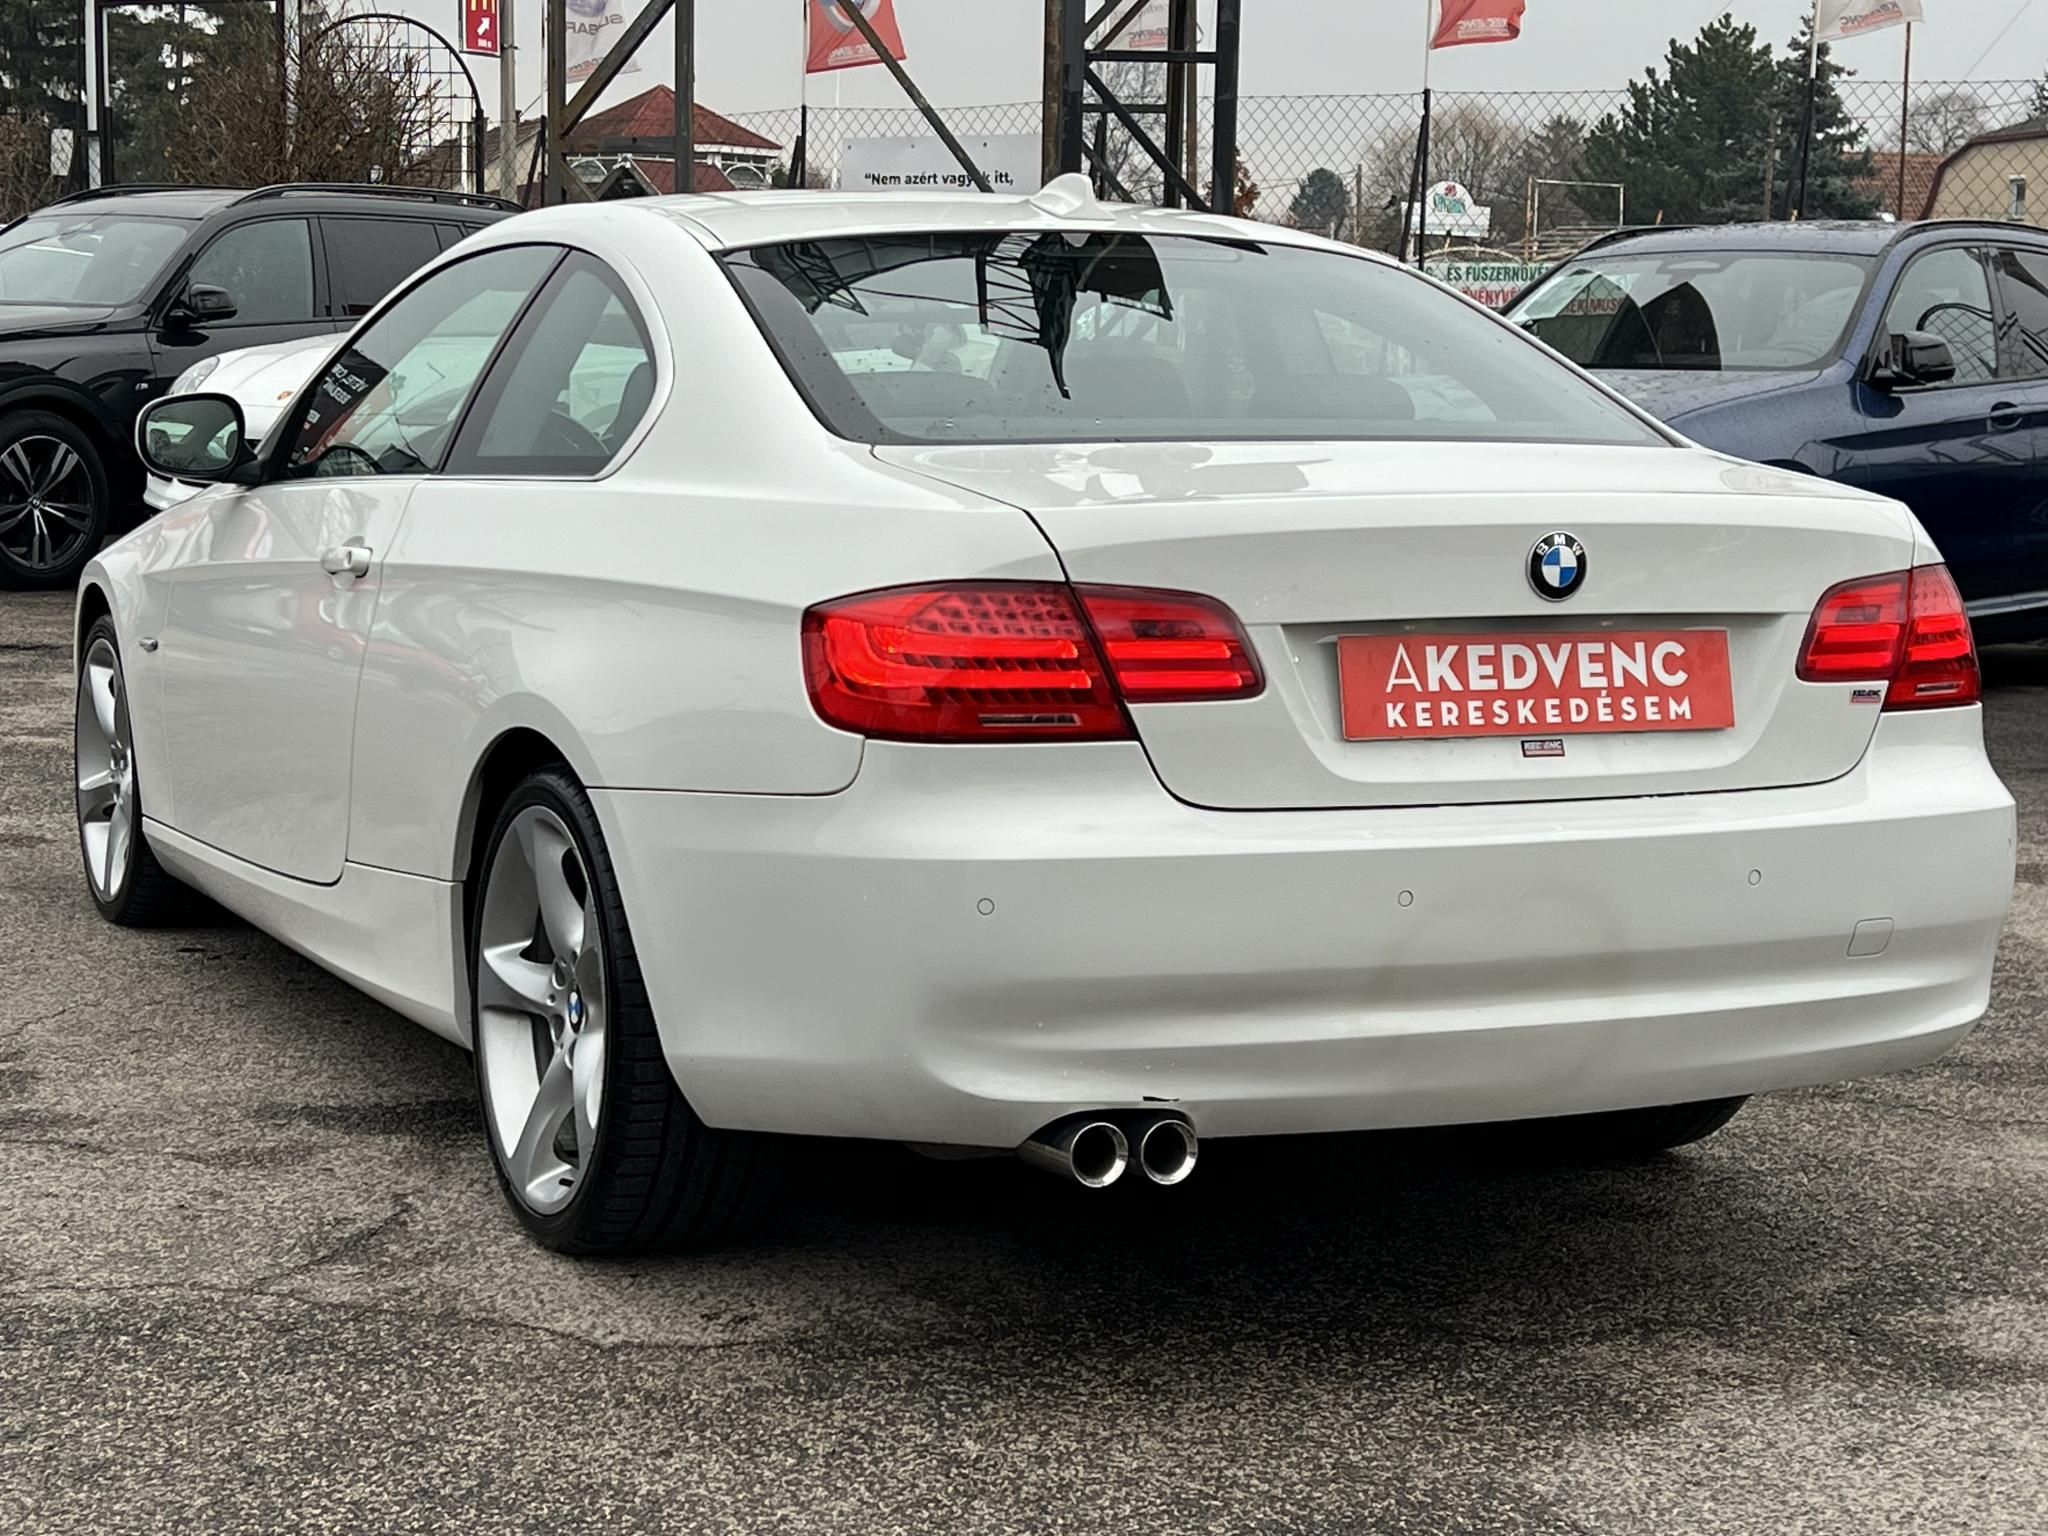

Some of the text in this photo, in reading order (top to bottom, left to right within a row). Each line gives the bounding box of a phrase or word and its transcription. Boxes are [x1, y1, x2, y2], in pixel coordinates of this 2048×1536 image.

[904, 171, 938, 185] azért
[941, 171, 990, 187] vagyk
[995, 170, 1014, 186] itt,
[1536, 534, 1583, 556] BMW
[1386, 690, 1692, 728] KERESKEDÉSEM
